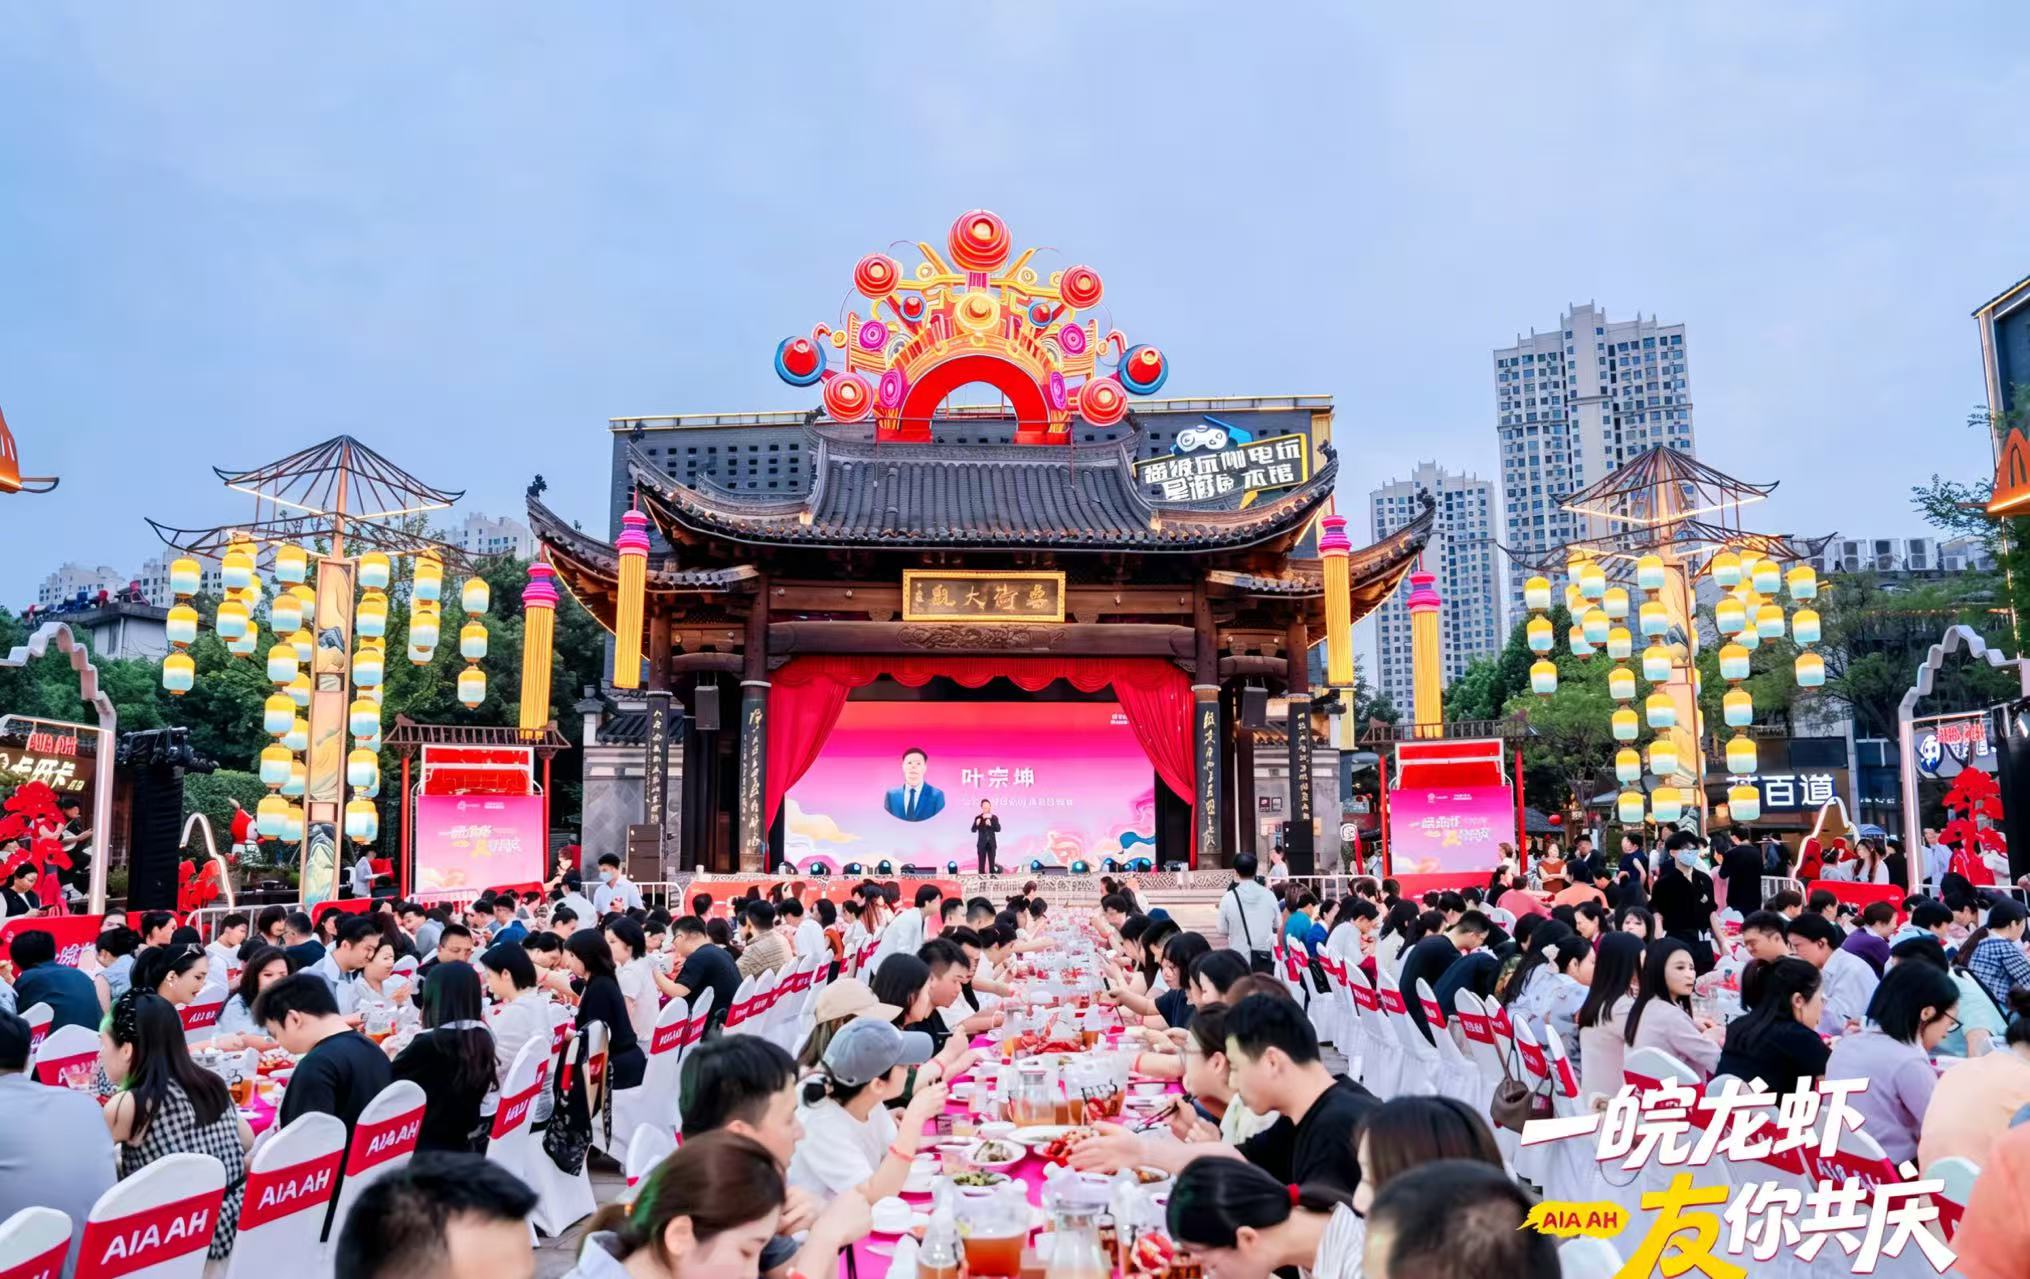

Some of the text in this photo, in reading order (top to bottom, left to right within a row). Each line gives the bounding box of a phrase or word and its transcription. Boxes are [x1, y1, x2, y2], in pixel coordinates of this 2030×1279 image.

[961, 767, 1035, 789] 叶宗坤
[366, 1120, 420, 1157] AIA AH
[258, 1168, 331, 1210] AIA AH
[101, 1208, 209, 1265] AIA AH
